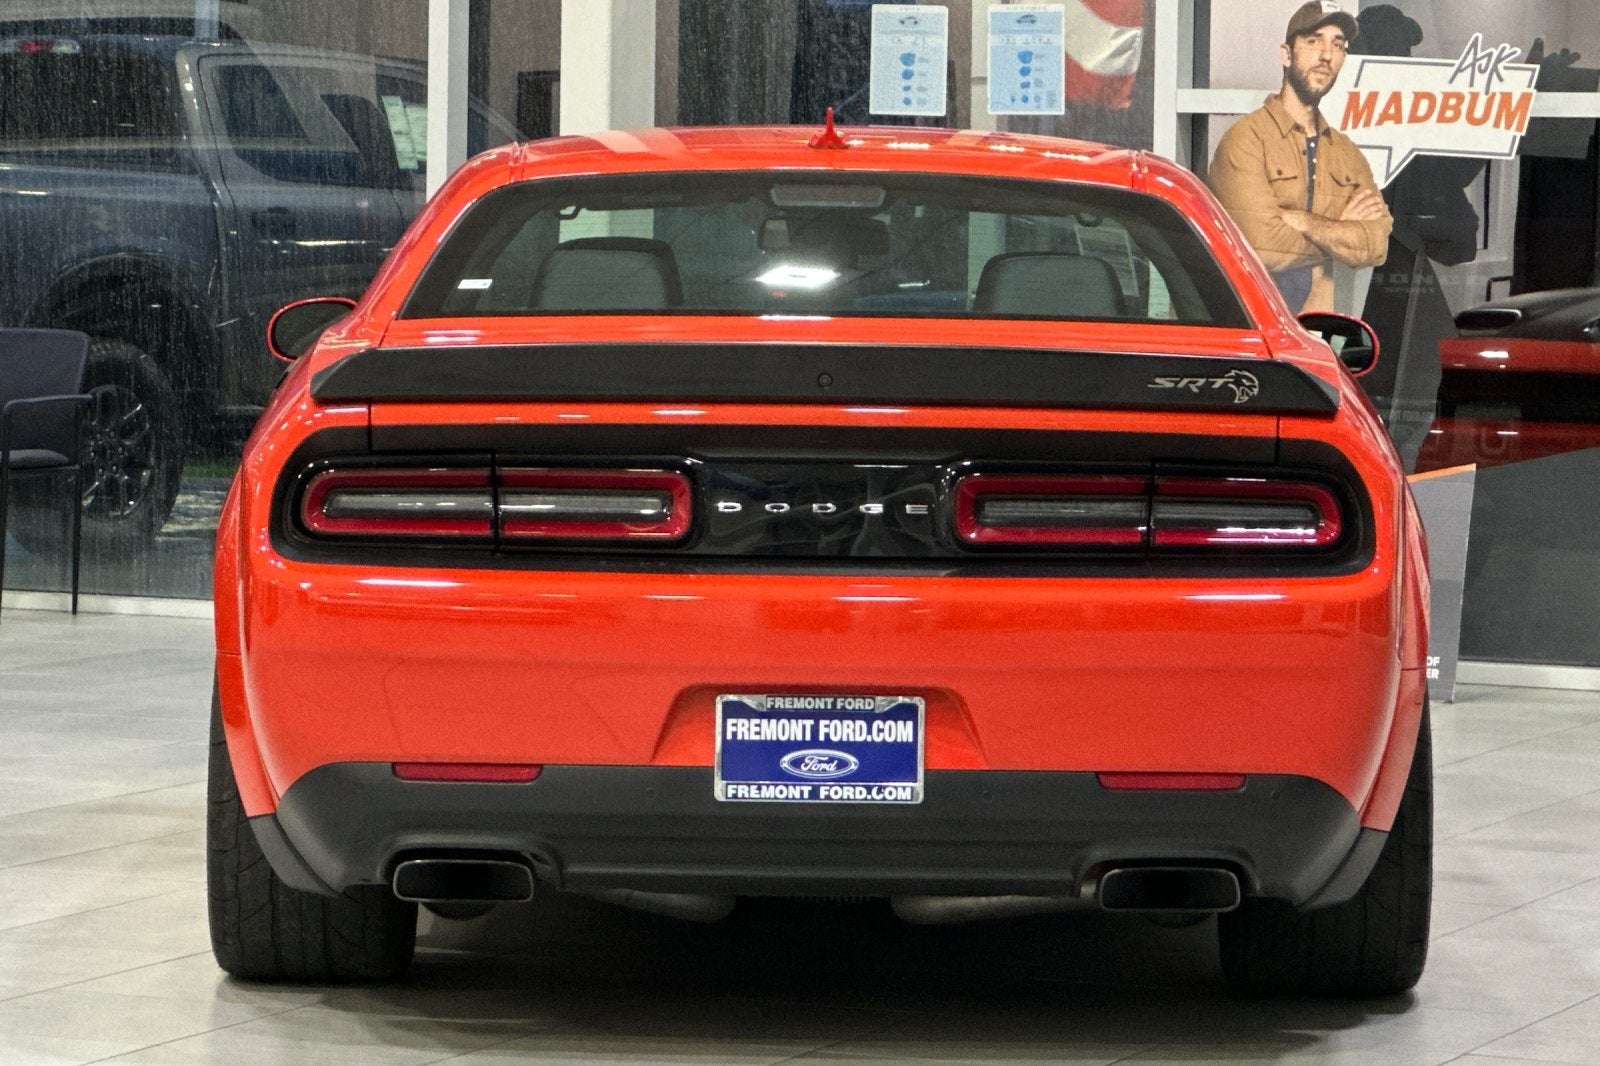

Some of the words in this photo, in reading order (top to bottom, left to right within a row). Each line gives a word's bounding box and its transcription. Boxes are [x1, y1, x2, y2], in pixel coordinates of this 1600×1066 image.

[1340, 90, 1534, 134] MADBUM
[1147, 377, 1234, 393] SRT
[716, 501, 929, 515] DODGE
[766, 697, 835, 710] FREMONT
[836, 698, 876, 711] FORD
[726, 718, 815, 741] FREMONT
[819, 719, 914, 743] FORD.COM
[800, 755, 837, 772] Ford
[726, 784, 813, 799] FREMONT
[819, 785, 912, 800] FORD.COM
